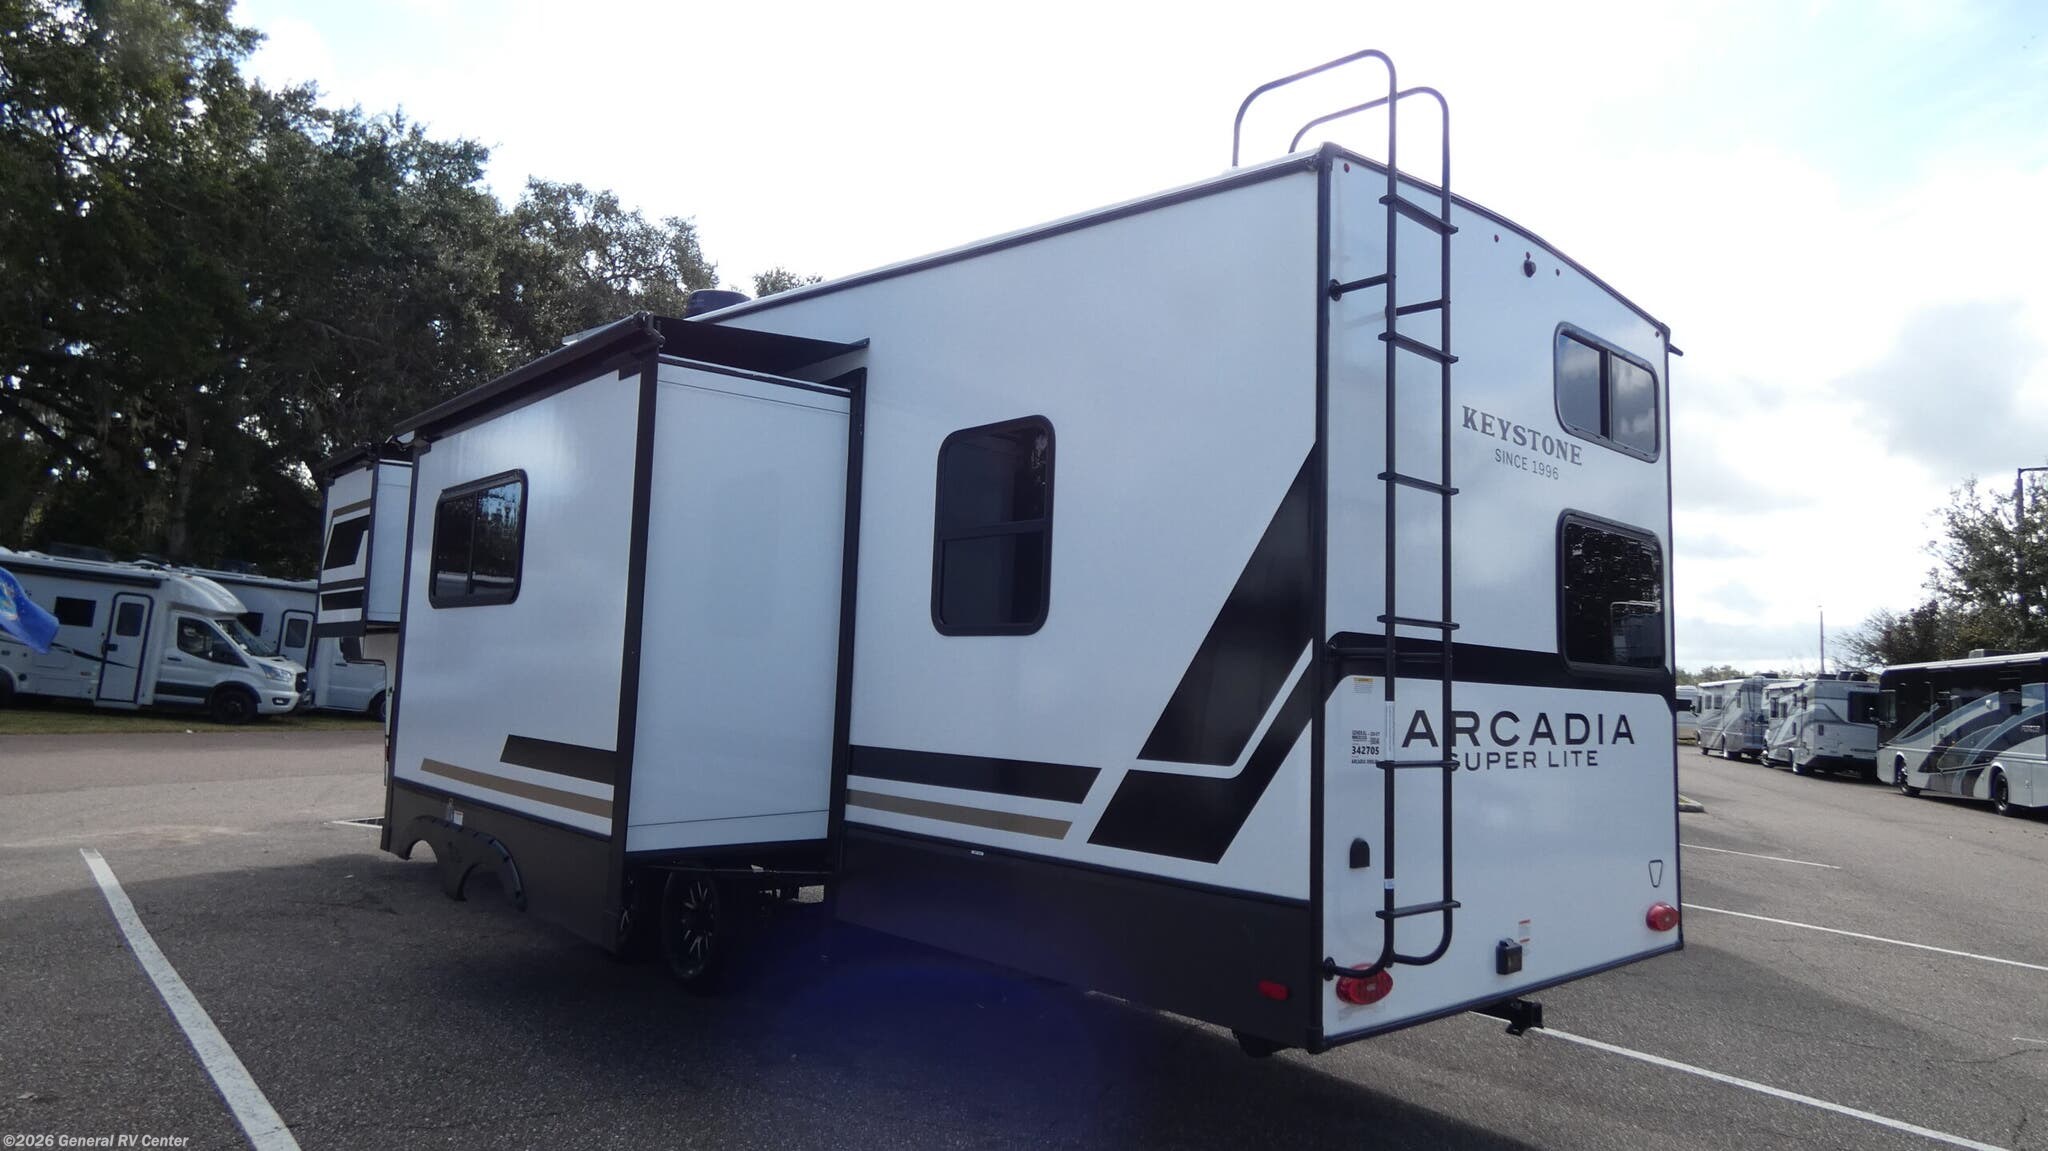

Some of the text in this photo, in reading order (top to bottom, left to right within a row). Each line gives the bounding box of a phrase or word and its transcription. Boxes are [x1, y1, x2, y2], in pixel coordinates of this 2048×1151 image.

[1462, 406, 1582, 466] KEYSTONE
[1495, 448, 1559, 480] SINCE 1996
[1402, 710, 1635, 748] ARCADIA
[1352, 746, 1379, 755] 342705
[1548, 750, 1598, 767] LITE
